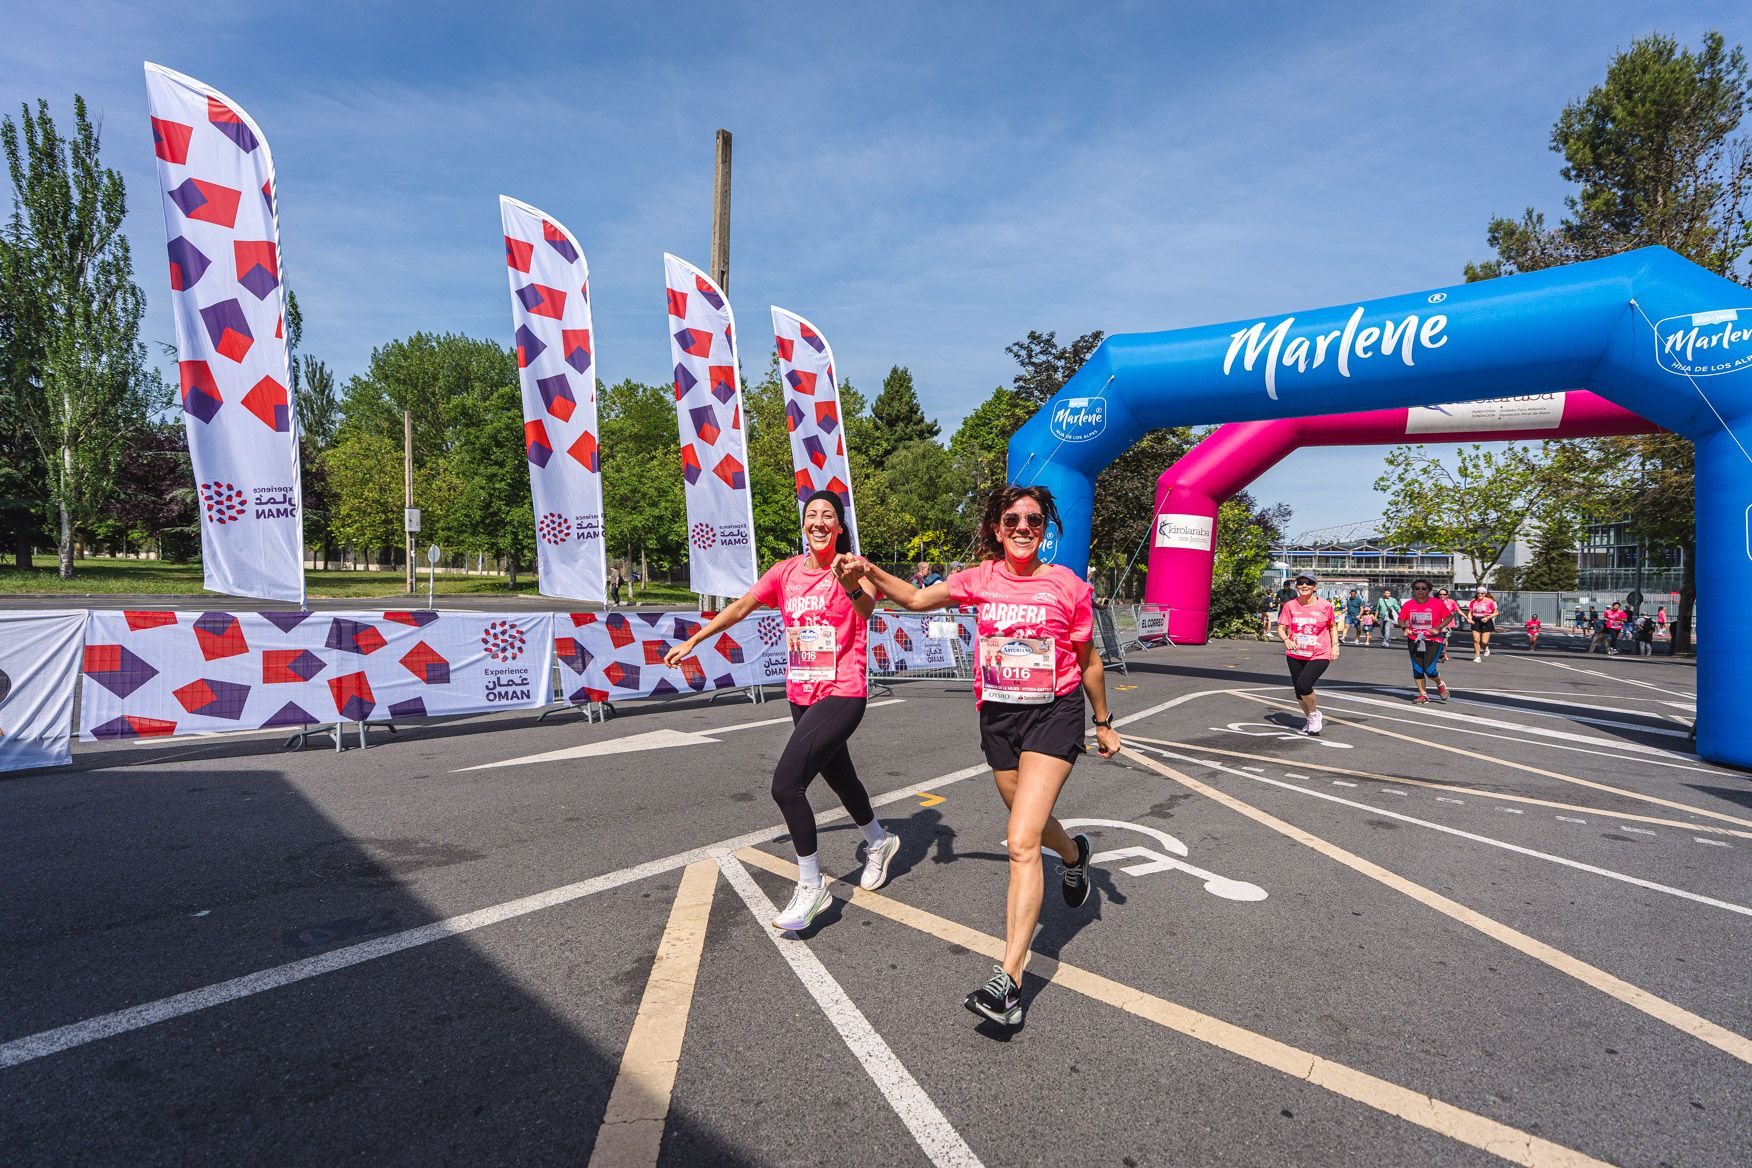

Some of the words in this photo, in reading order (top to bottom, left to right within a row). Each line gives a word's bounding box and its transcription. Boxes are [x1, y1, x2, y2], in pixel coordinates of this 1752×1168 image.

[1664, 322, 1752, 361] Marlen
[1223, 306, 1448, 400] Marlene
[1711, 362, 1731, 371] LOS
[1734, 355, 1752, 367] ALP
[1054, 408, 1103, 430] Marlene
[1168, 525, 1210, 537] kirolaraba
[982, 602, 1047, 625] CARRERA
[1142, 619, 1147, 629] EL
[1148, 618, 1164, 628] CORREO
[802, 651, 817, 660] 016
[484, 667, 529, 676] Experience
[1002, 667, 1031, 679] 016
[485, 689, 531, 702] OMAN
[989, 691, 1010, 700] OYSHO
